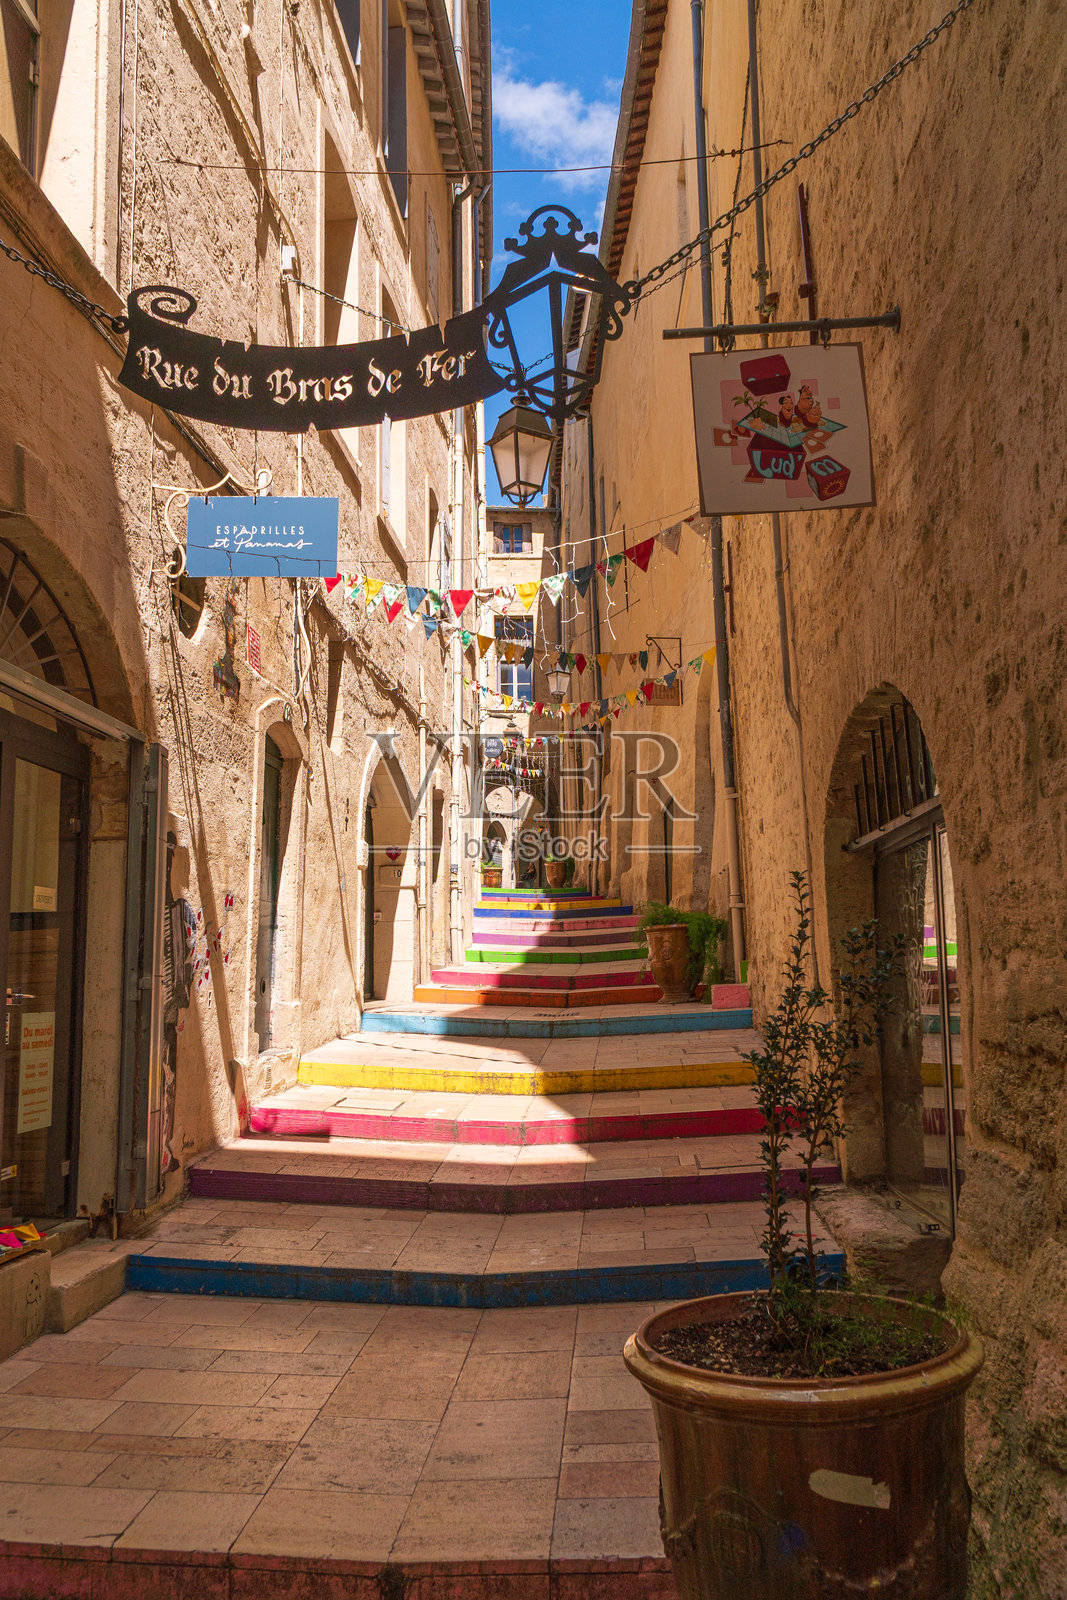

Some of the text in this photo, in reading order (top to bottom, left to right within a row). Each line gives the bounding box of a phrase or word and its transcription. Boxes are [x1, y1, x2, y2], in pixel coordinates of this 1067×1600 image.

[135, 345, 477, 406] Rue du Bras de Fer
[216, 525, 305, 535] ESPADRILLES
[208, 532, 313, 553] et Panamas
[23, 1024, 54, 1038] Du mardi
[21, 1037, 54, 1051] au samedi
